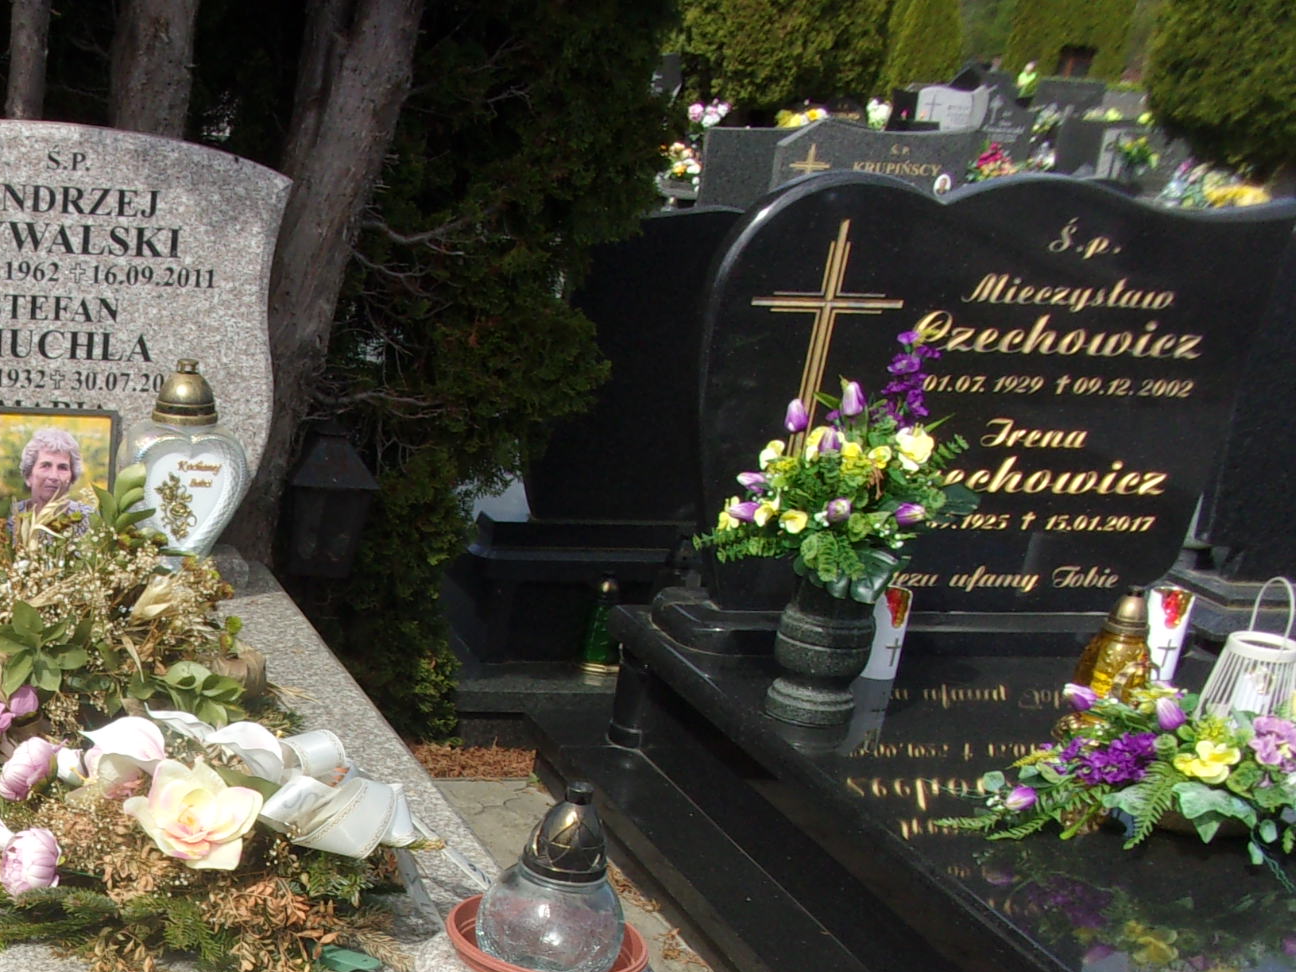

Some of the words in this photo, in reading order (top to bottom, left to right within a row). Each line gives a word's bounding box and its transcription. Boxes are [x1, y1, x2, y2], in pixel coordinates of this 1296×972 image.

[92, 264, 216, 289] 16.09.2011
[961, 272, 1177, 312] Mieczysław
[71, 371, 164, 392] 30.07.20
[1044, 515, 1156, 533] 15.01.2017
[949, 564, 1040, 593] ufamy
[1051, 564, 1120, 589] Tobie
